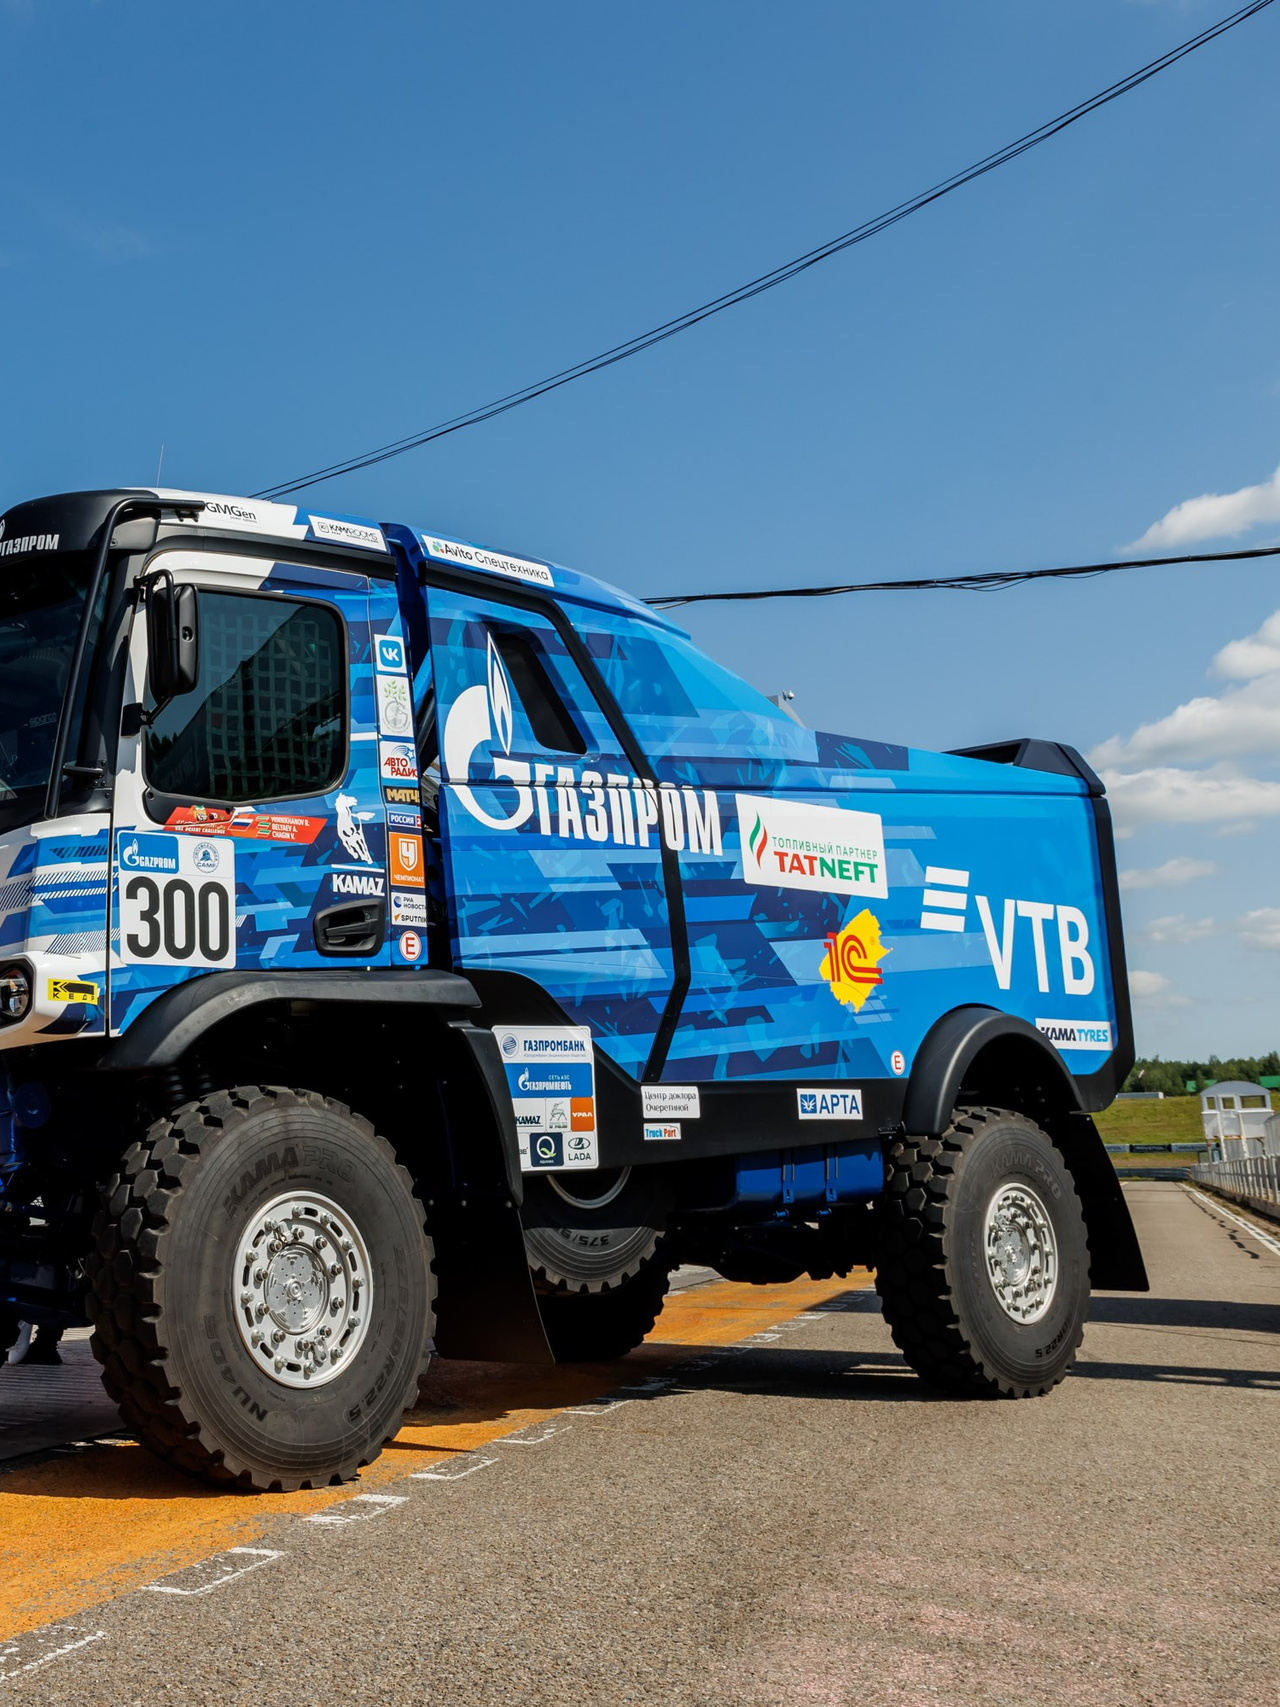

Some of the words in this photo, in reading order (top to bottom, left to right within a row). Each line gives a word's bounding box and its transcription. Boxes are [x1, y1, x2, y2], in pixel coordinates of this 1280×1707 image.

[205, 502, 256, 520] GMGen
[1, 534, 59, 556] ГАЗПРОМ
[444, 543, 473, 561] Avito
[475, 552, 549, 582] Спецтехника
[382, 647, 399, 662] VK
[384, 757, 408, 767] АВТО
[535, 763, 723, 857] ГАЗПРОМ
[391, 814, 414, 825] РОССИЯ
[772, 836, 833, 855] ТОПЛИВНЫЙ
[836, 845, 878, 860] ПАРТНЕР
[139, 856, 176, 870] GAZPROM
[773, 850, 878, 884] TATNEFT
[332, 874, 385, 897] KAMAZ
[126, 876, 229, 961] 300
[974, 895, 1095, 996] VTB
[1040, 1026, 1076, 1042] KAMA
[1077, 1028, 1108, 1043] TYRES
[523, 1040, 586, 1052] ГАЗПРОМБАНК
[529, 1081, 572, 1091] ГАЗПРОМНЕФТЬ
[645, 1091, 667, 1101] Центр
[669, 1093, 696, 1101] доктора
[646, 1103, 689, 1113] Очеретиной
[515, 1115, 541, 1125] KAMAZ
[645, 1128, 663, 1138] Truck
[664, 1128, 677, 1138] Part
[568, 1153, 591, 1161] LADA
[223, 1147, 299, 1218] KAMA
[303, 1145, 358, 1182] PRO
